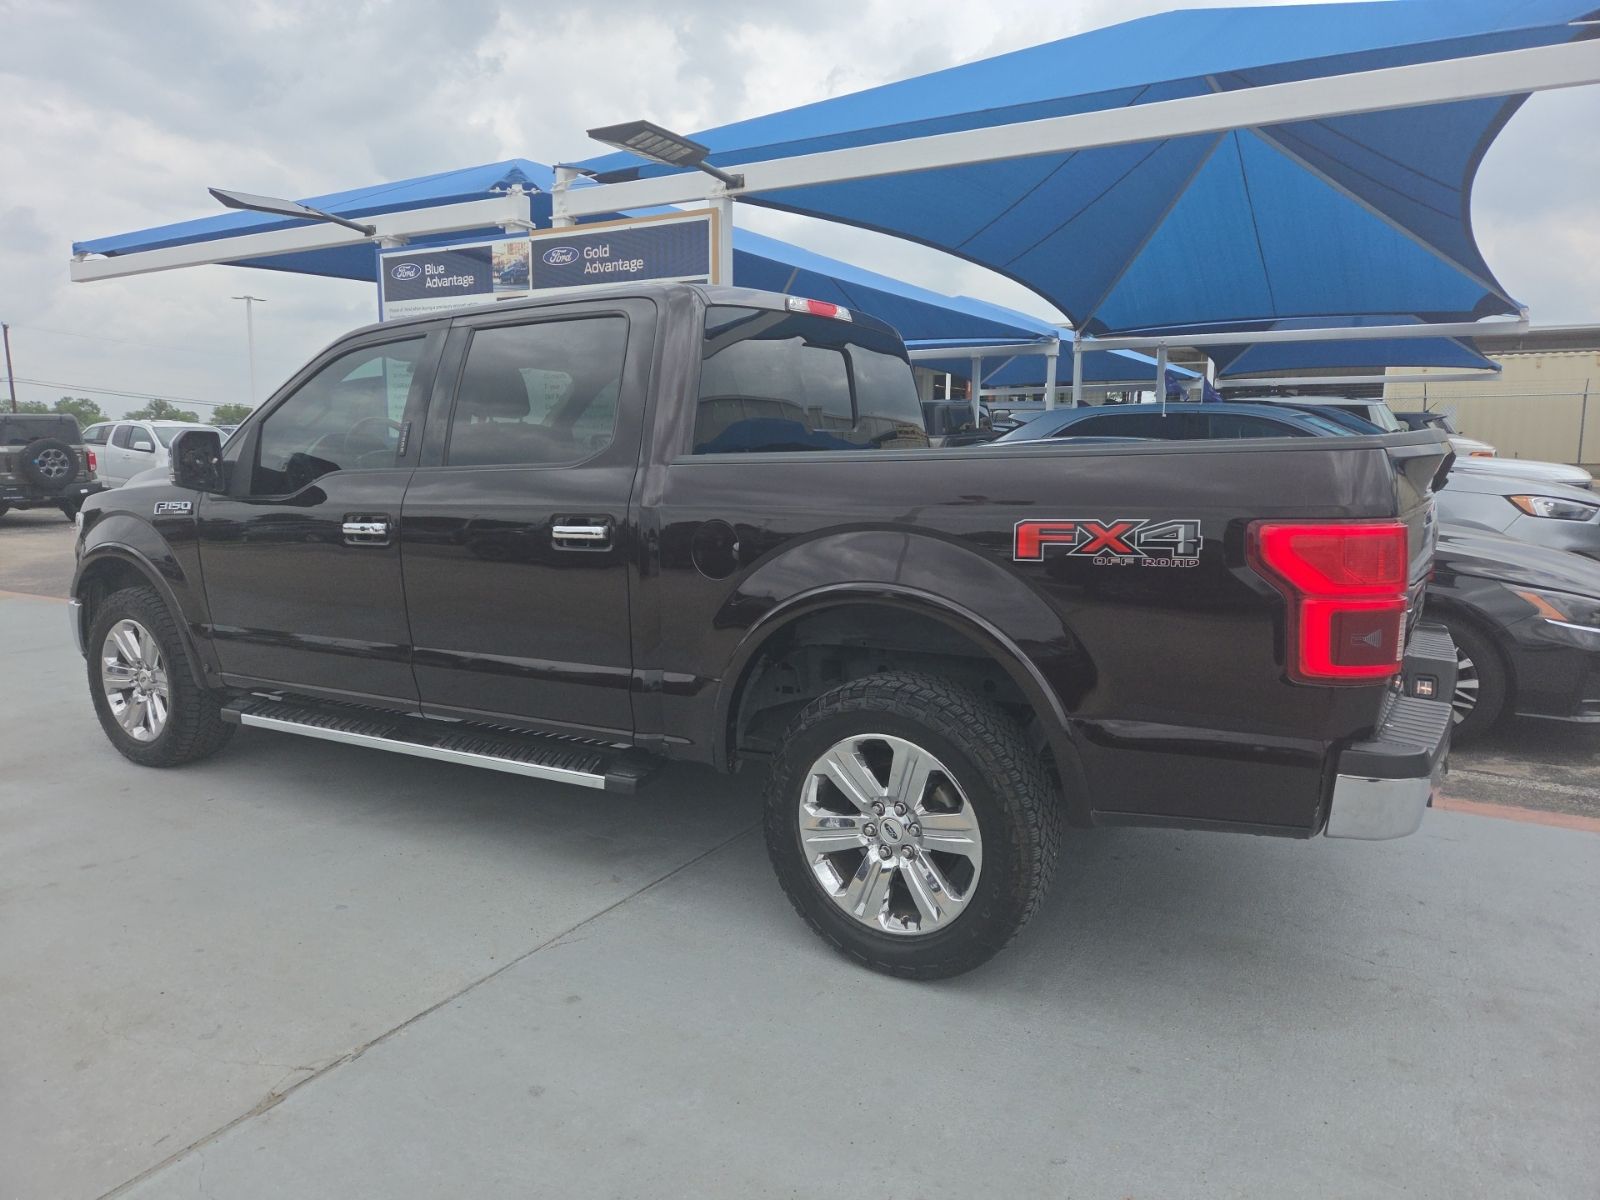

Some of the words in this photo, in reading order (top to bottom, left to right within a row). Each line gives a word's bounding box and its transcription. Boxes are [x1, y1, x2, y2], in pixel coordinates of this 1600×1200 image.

[548, 248, 573, 264] Ford
[584, 244, 610, 258] Gold
[395, 264, 417, 279] Ford
[425, 264, 444, 275] Blue
[584, 258, 644, 274] Advantage
[426, 274, 474, 288] Advantage
[1013, 519, 1203, 561] FX4
[1093, 557, 1134, 566] OFF
[1142, 558, 1200, 568] ROAD
